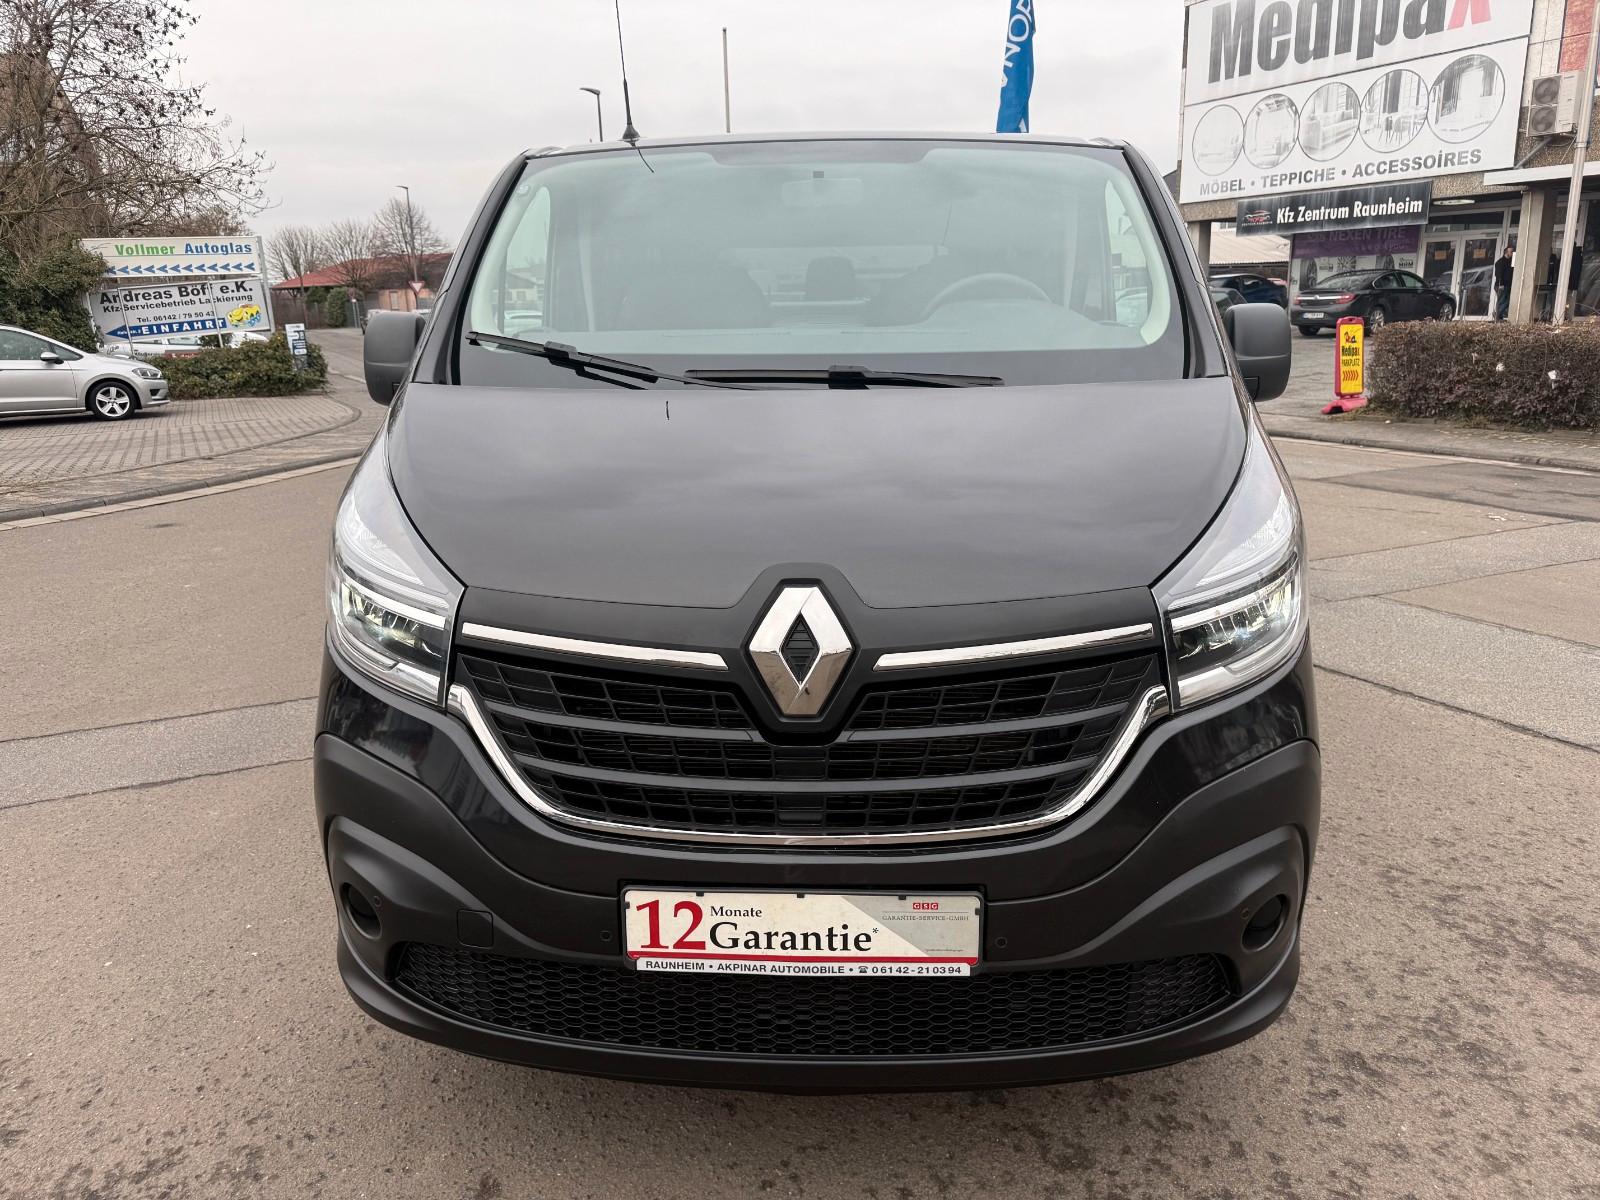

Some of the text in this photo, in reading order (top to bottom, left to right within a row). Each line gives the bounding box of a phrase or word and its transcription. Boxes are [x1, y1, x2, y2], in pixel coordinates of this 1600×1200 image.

[1199, 178, 1246, 196] MÖBEL
[1261, 167, 1336, 189] TEPPICHE
[1277, 197, 1423, 224] Kfz Zentrum Raunheim
[1329, 228, 1374, 241] NEXEN
[1376, 226, 1406, 240] TIRE
[115, 243, 252, 256] Vollmer Autoglas
[100, 290, 173, 304] Andreas
[220, 281, 253, 294] e.K.
[142, 319, 224, 335] EINFAHRT
[710, 905, 763, 918] Monate
[913, 902, 939, 910] GSG
[636, 899, 706, 950] 12
[645, 960, 962, 974] RAUNHEIM AKPINAR AUTOMOBILE 06142-210394
